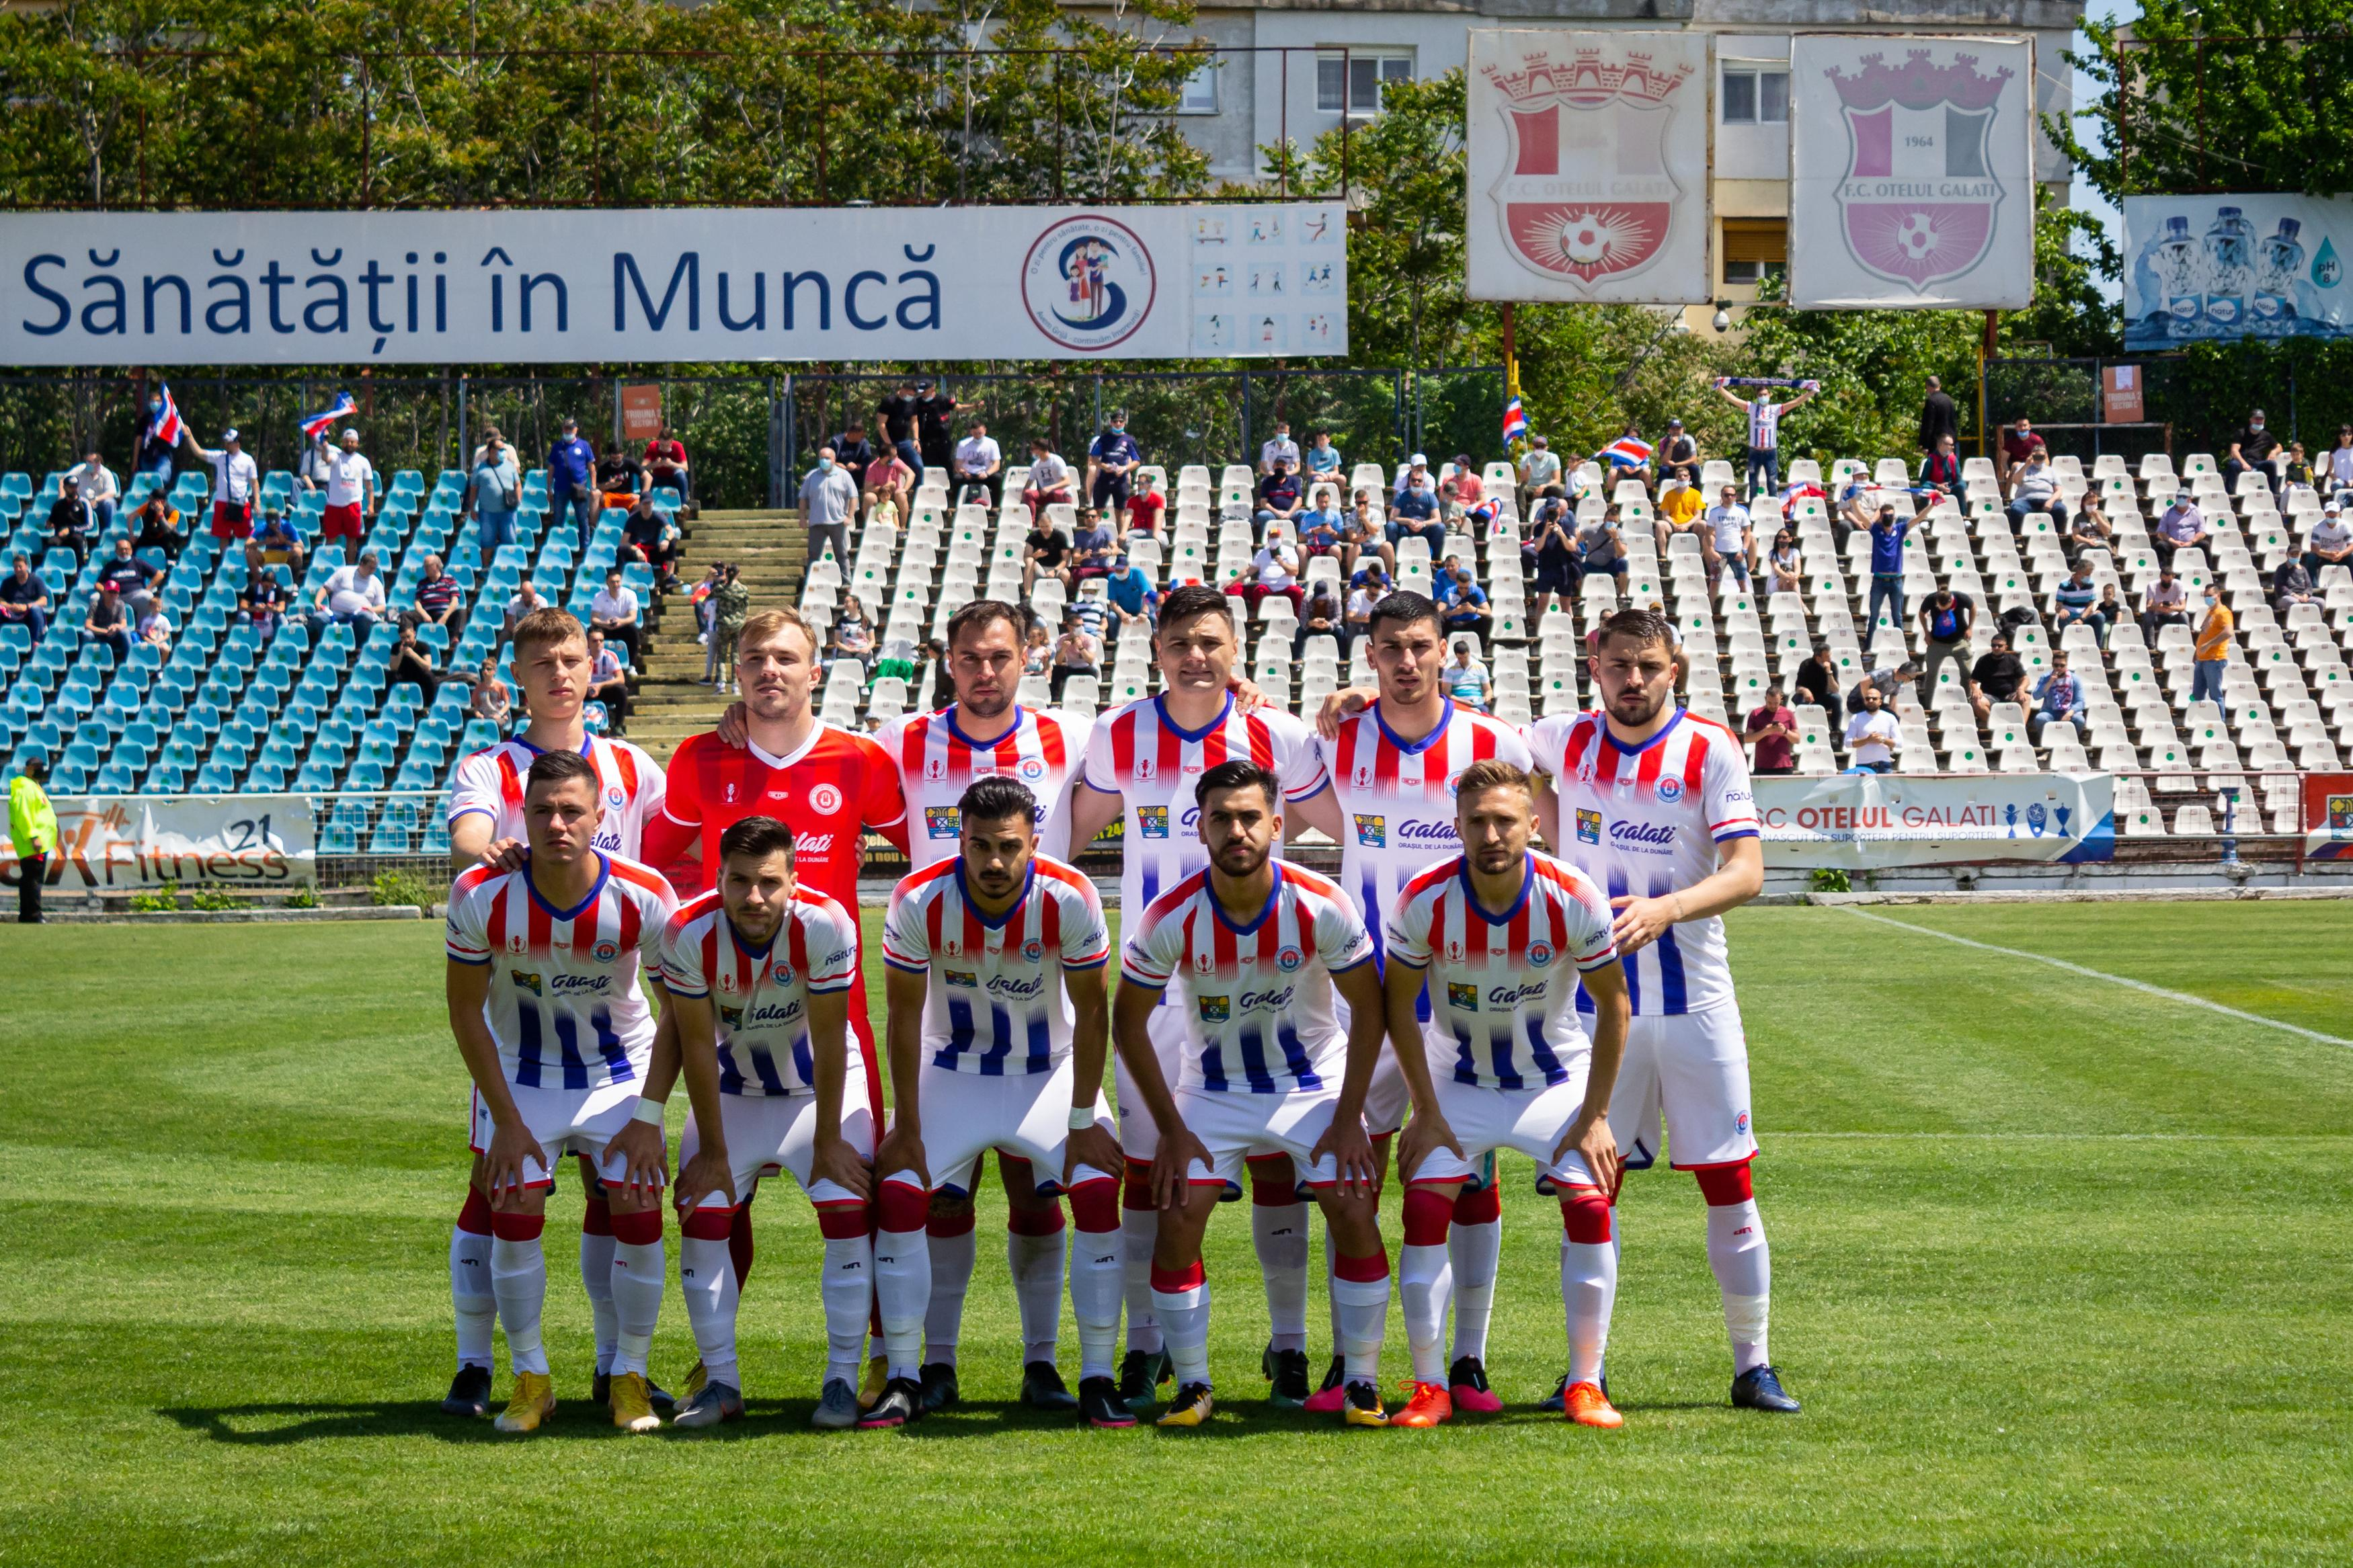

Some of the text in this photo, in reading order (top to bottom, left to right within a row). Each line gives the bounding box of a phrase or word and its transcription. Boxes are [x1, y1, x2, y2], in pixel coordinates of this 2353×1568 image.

[1905, 136, 1933, 147] 1964
[1845, 183, 1995, 197] F.C. OTELUL GALATI
[2318, 260, 2336, 275] pH
[2323, 273, 2330, 284] 8
[481, 246, 569, 333] în
[614, 243, 941, 333] Muncă
[2210, 308, 2235, 316] natur
[2256, 302, 2278, 311] natur
[2108, 392, 2142, 402] TRIBUNA 2
[2112, 401, 2133, 409] SECTOR
[625, 409, 656, 419] TRIBUNA
[631, 418, 653, 428] SECTOR
[1796, 806, 1894, 829] OTELUL
[1902, 804, 1997, 828] GALATI
[230, 813, 271, 852] 21
[1812, 833, 1828, 843] DE
[1831, 832, 1888, 843] SUPORTERI
[1892, 832, 1933, 842] PENTRU
[1937, 831, 1997, 841] SUPORTERI
[106, 839, 289, 886] Fitness
